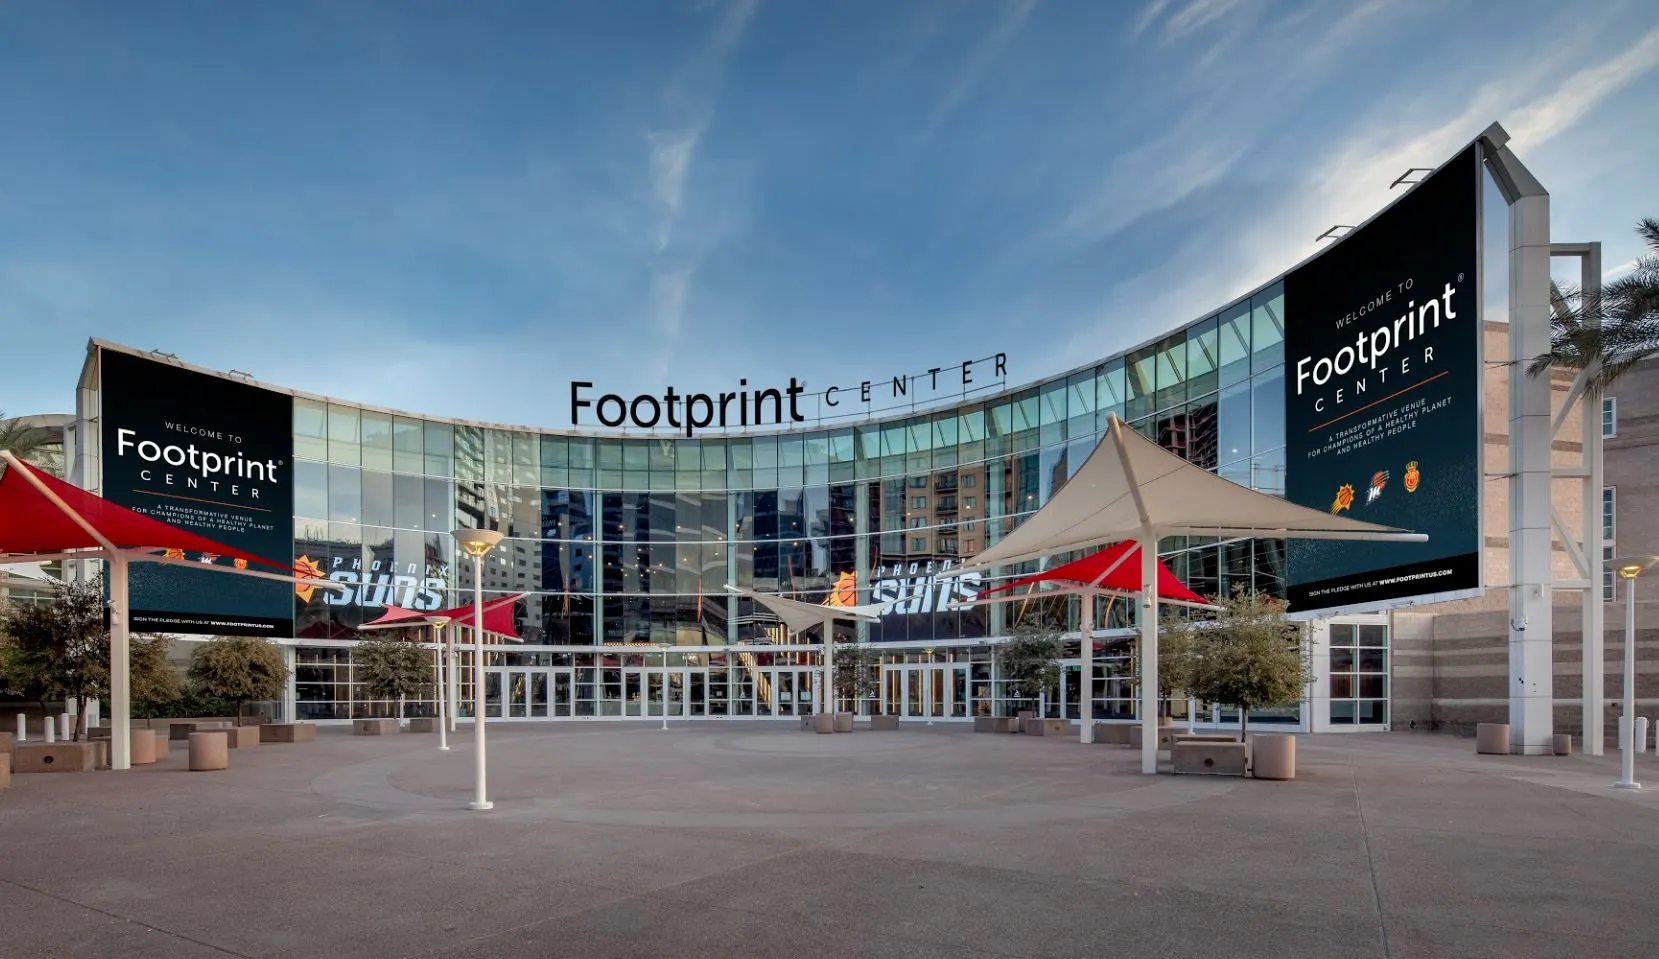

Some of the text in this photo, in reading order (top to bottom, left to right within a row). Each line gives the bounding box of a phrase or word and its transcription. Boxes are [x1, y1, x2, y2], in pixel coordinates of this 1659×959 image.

[1336, 278, 1414, 329] WELCOME TO
[570, 352, 1007, 438] Footprint CENTER
[1315, 346, 1434, 412] CENTER
[165, 421, 242, 444] WELCOME TO
[1308, 449, 1320, 458] FOR
[1323, 433, 1363, 453] CHAMPIONS
[1366, 428, 1375, 437] OF
[1386, 411, 1418, 428] HEALTHY
[1422, 396, 1452, 414] PLANET
[1336, 409, 1398, 439] TRANSFORMATIVE
[1401, 398, 1426, 414] VENUE
[1337, 420, 1416, 456] AND HEALTHY PEOPLE
[140, 470, 259, 499] CENTER
[132, 506, 148, 514] FOR
[150, 509, 194, 520] CHAMPIONS
[216, 519, 246, 527] HEALTHY
[250, 523, 274, 531] PLANET
[165, 505, 228, 519] TRANSFORMATIVE
[184, 520, 216, 529] HEALTHY
[218, 524, 245, 532] PEOPLE
[323, 571, 446, 610] SUNS
[1380, 569, 1452, 586] WWW.FOOTPRINTUS.COM
